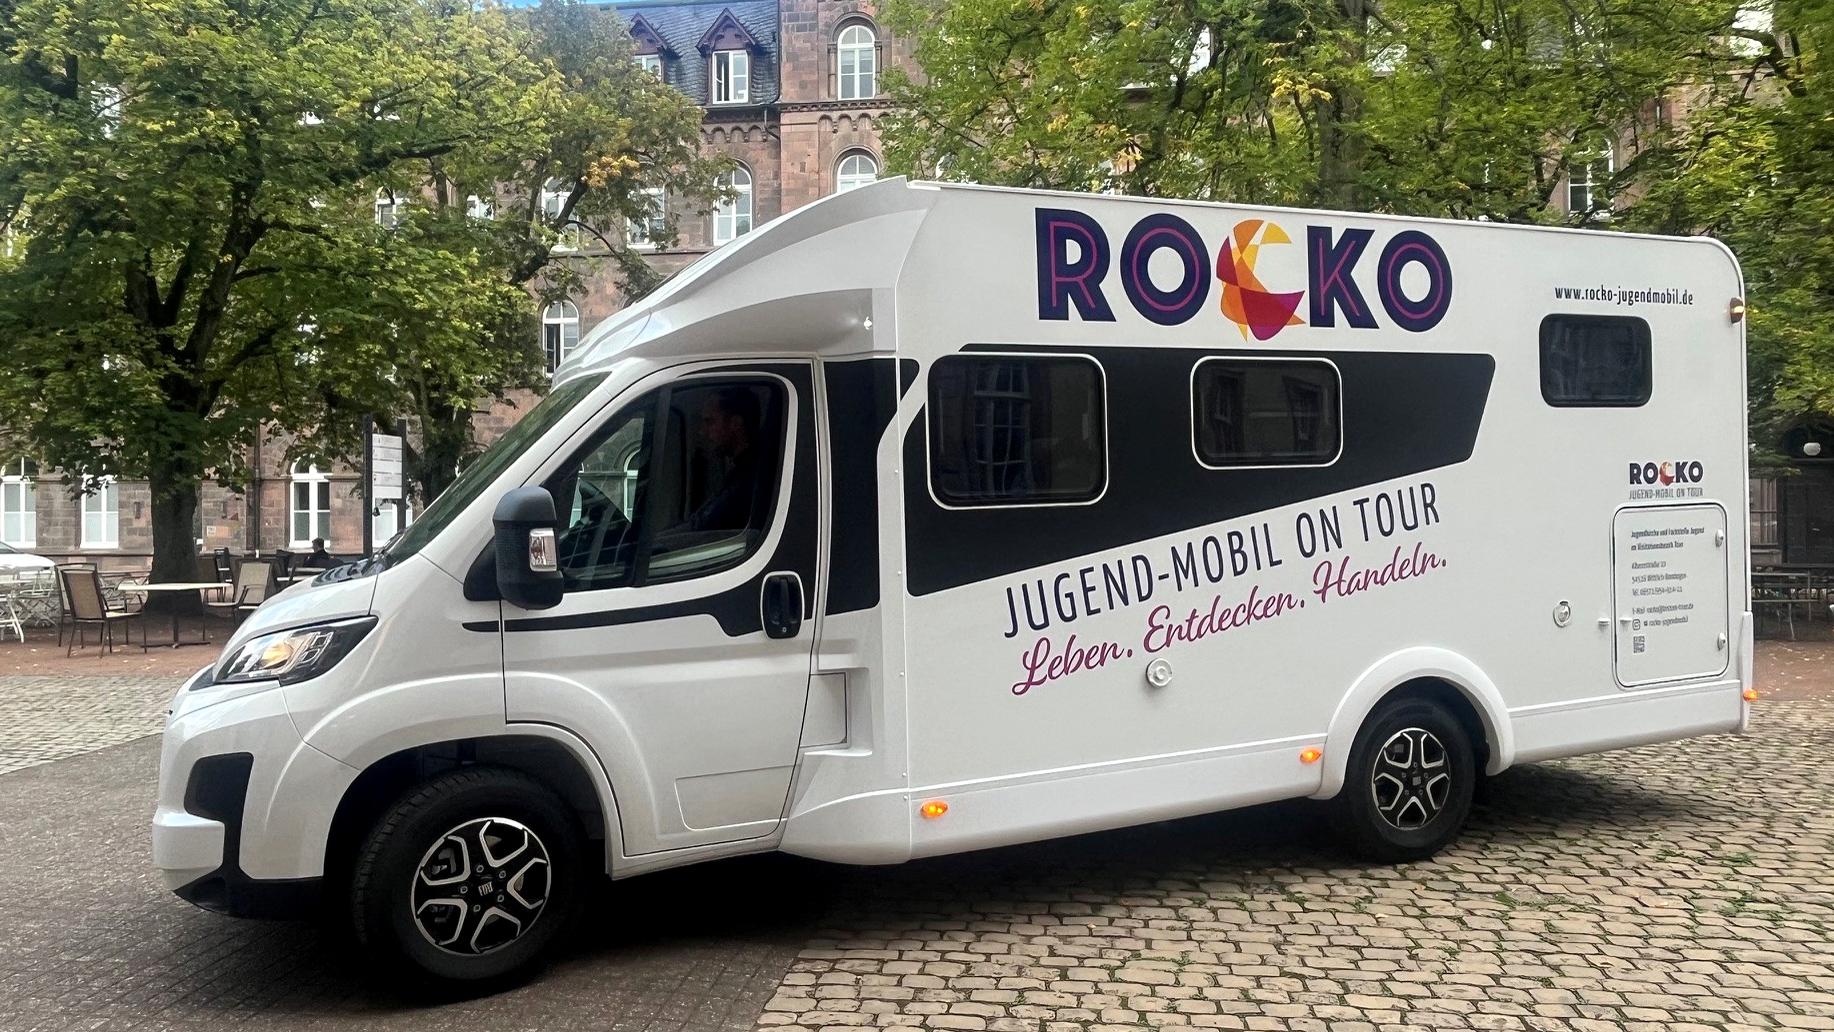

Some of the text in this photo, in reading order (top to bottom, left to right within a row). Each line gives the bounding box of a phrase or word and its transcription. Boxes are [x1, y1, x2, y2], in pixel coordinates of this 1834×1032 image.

[1035, 207, 1453, 342] ROCKO
[1554, 284, 1693, 306] www.rocko-jugendmobil.de
[1629, 461, 1703, 486] ROCKO
[1004, 482, 1440, 638] JUGEND-MOBIL ON TOUR
[1012, 541, 1447, 696] Leben. Entdecken. Handeln.
